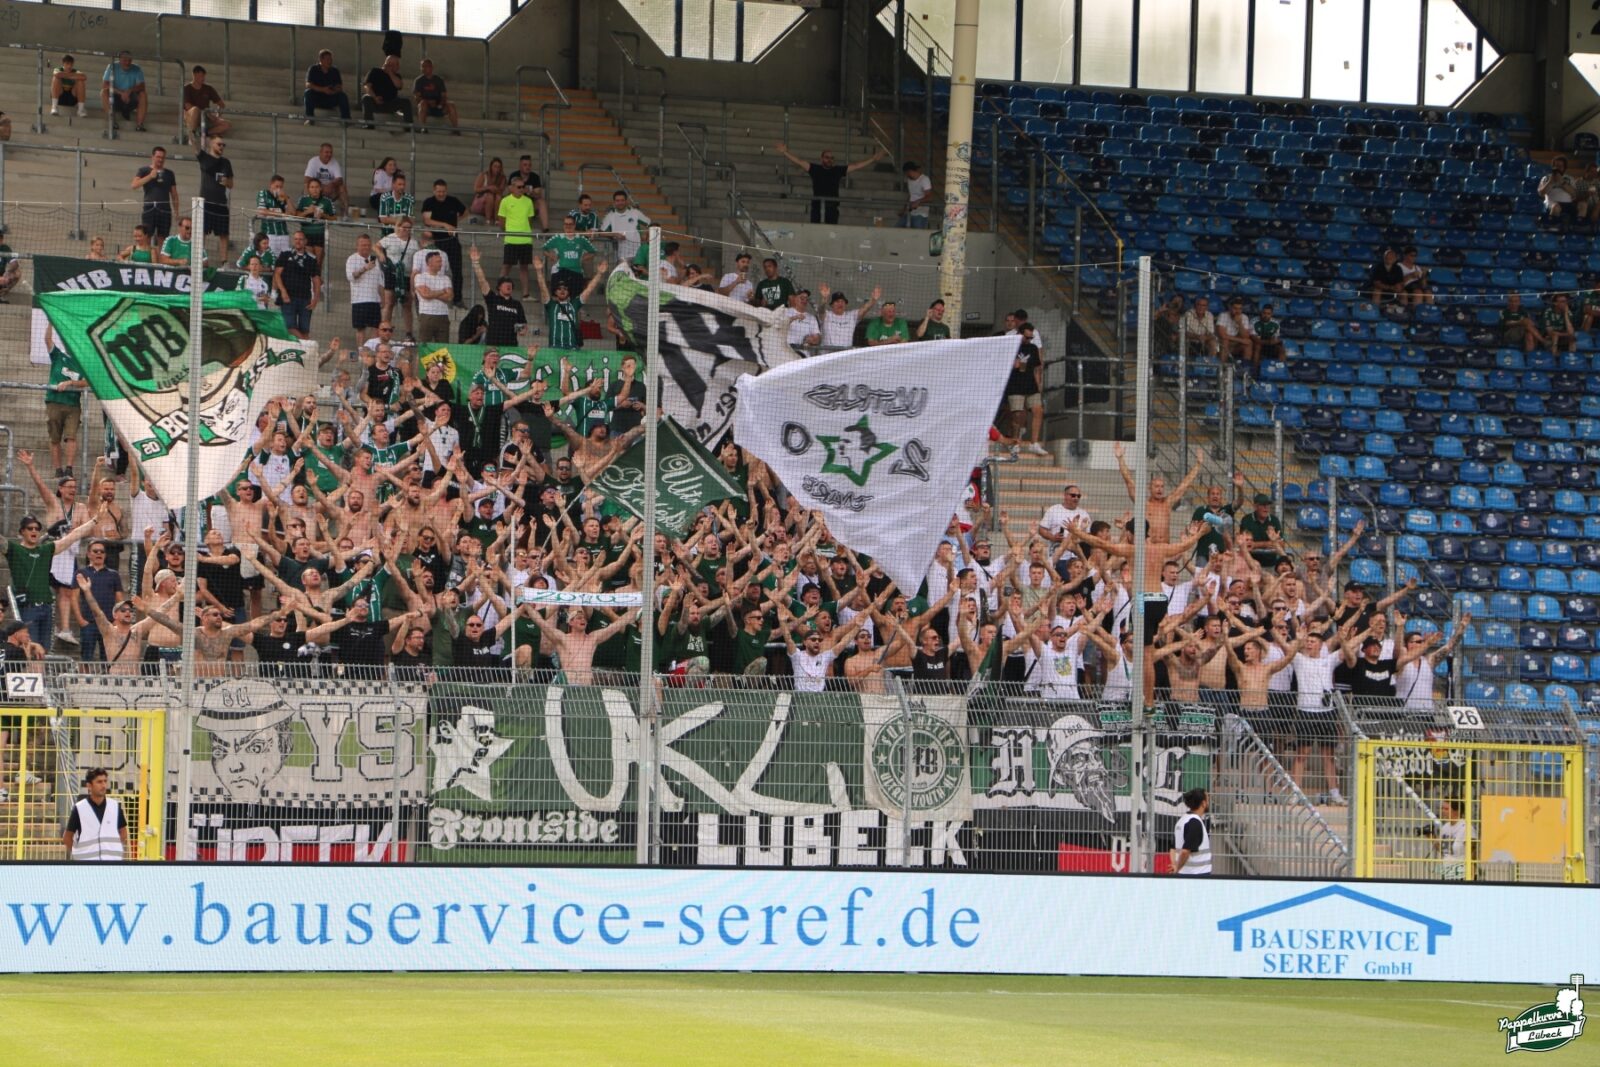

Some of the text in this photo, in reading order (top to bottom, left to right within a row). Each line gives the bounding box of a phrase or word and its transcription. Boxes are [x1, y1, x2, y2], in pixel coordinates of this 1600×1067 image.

[142, 441, 161, 456] 20
[11, 677, 39, 693] 27
[1453, 709, 1479, 726] 26
[428, 806, 620, 850] Frontside
[1250, 927, 1420, 952] BAUSERVICE
[1263, 953, 1413, 976] SEREF GmbH
